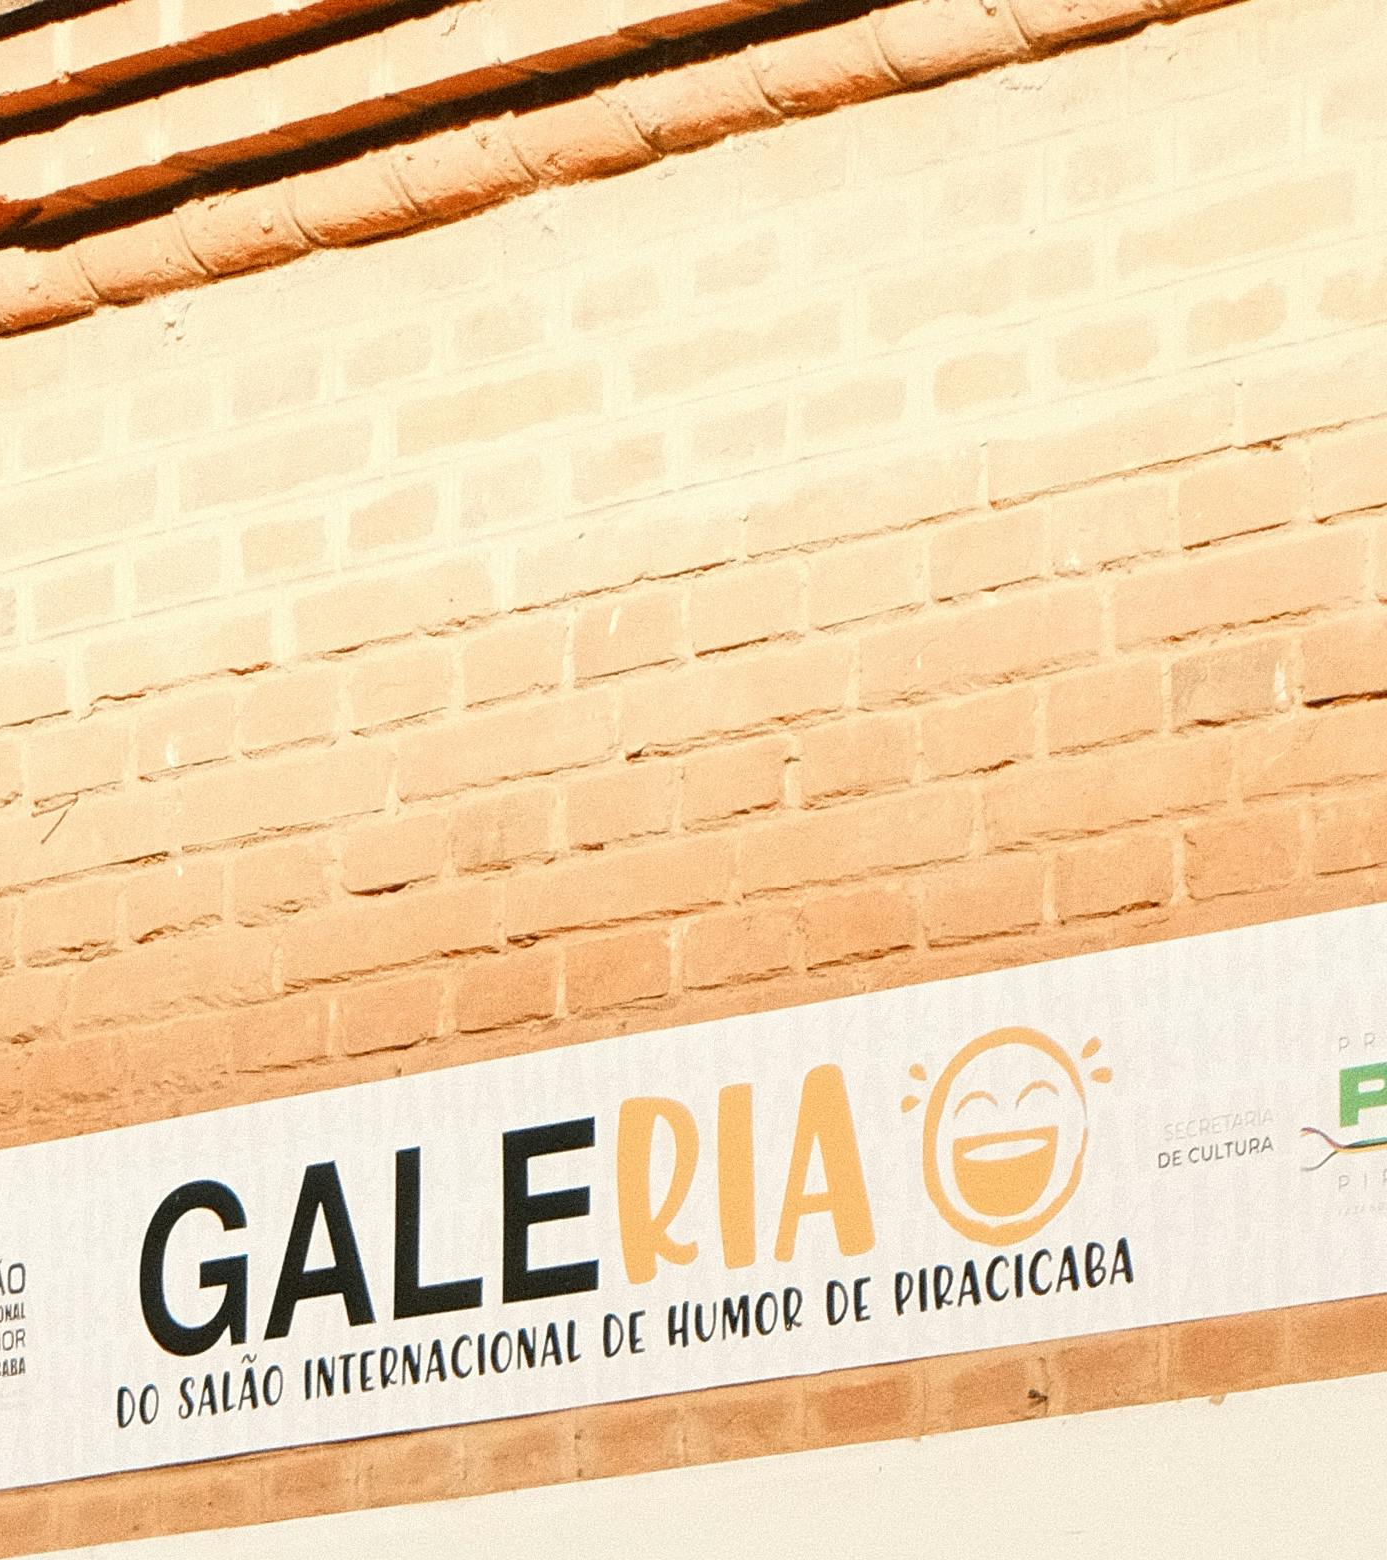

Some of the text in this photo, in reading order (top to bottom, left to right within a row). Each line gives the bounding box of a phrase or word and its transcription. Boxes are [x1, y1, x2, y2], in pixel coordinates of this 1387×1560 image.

[1158, 1136, 1274, 1169] DE CULTURA
[1163, 1108, 1274, 1142] SECRETARIA
[139, 1063, 876, 1358] GALERIA
[117, 1236, 1135, 1428] DO SALÃO INTERNACIONAL DE HUMOR DE PIRACICABA
